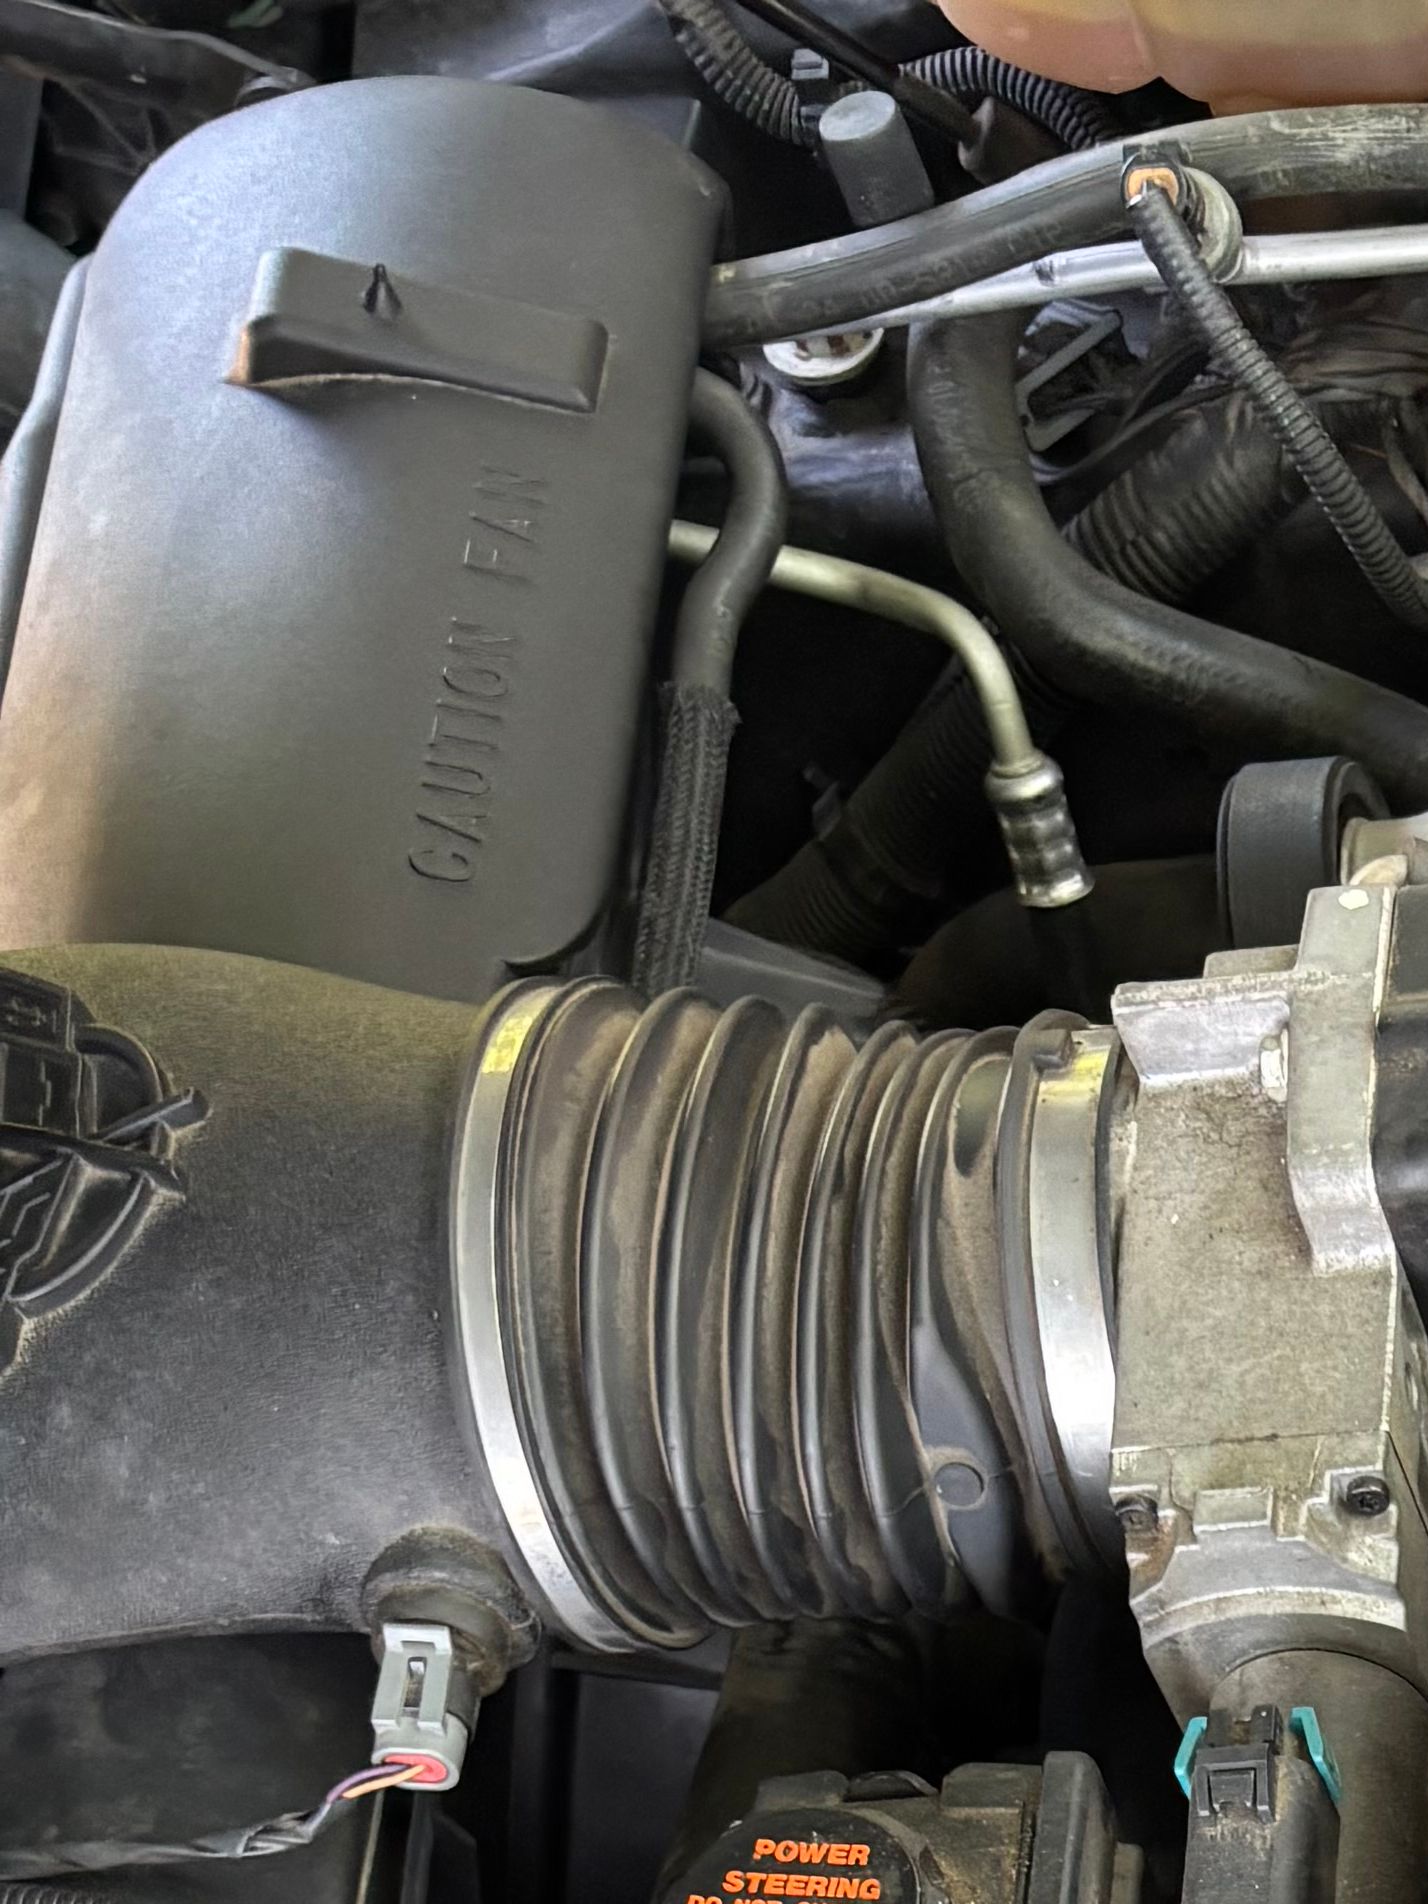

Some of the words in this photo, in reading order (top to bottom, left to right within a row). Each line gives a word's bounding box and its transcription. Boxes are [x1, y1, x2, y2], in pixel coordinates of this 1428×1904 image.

[408, 616, 517, 883] CAUTION
[463, 464, 547, 586] FAN
[753, 1838, 871, 1866] POWER
[722, 1871, 881, 1900] STEERING
